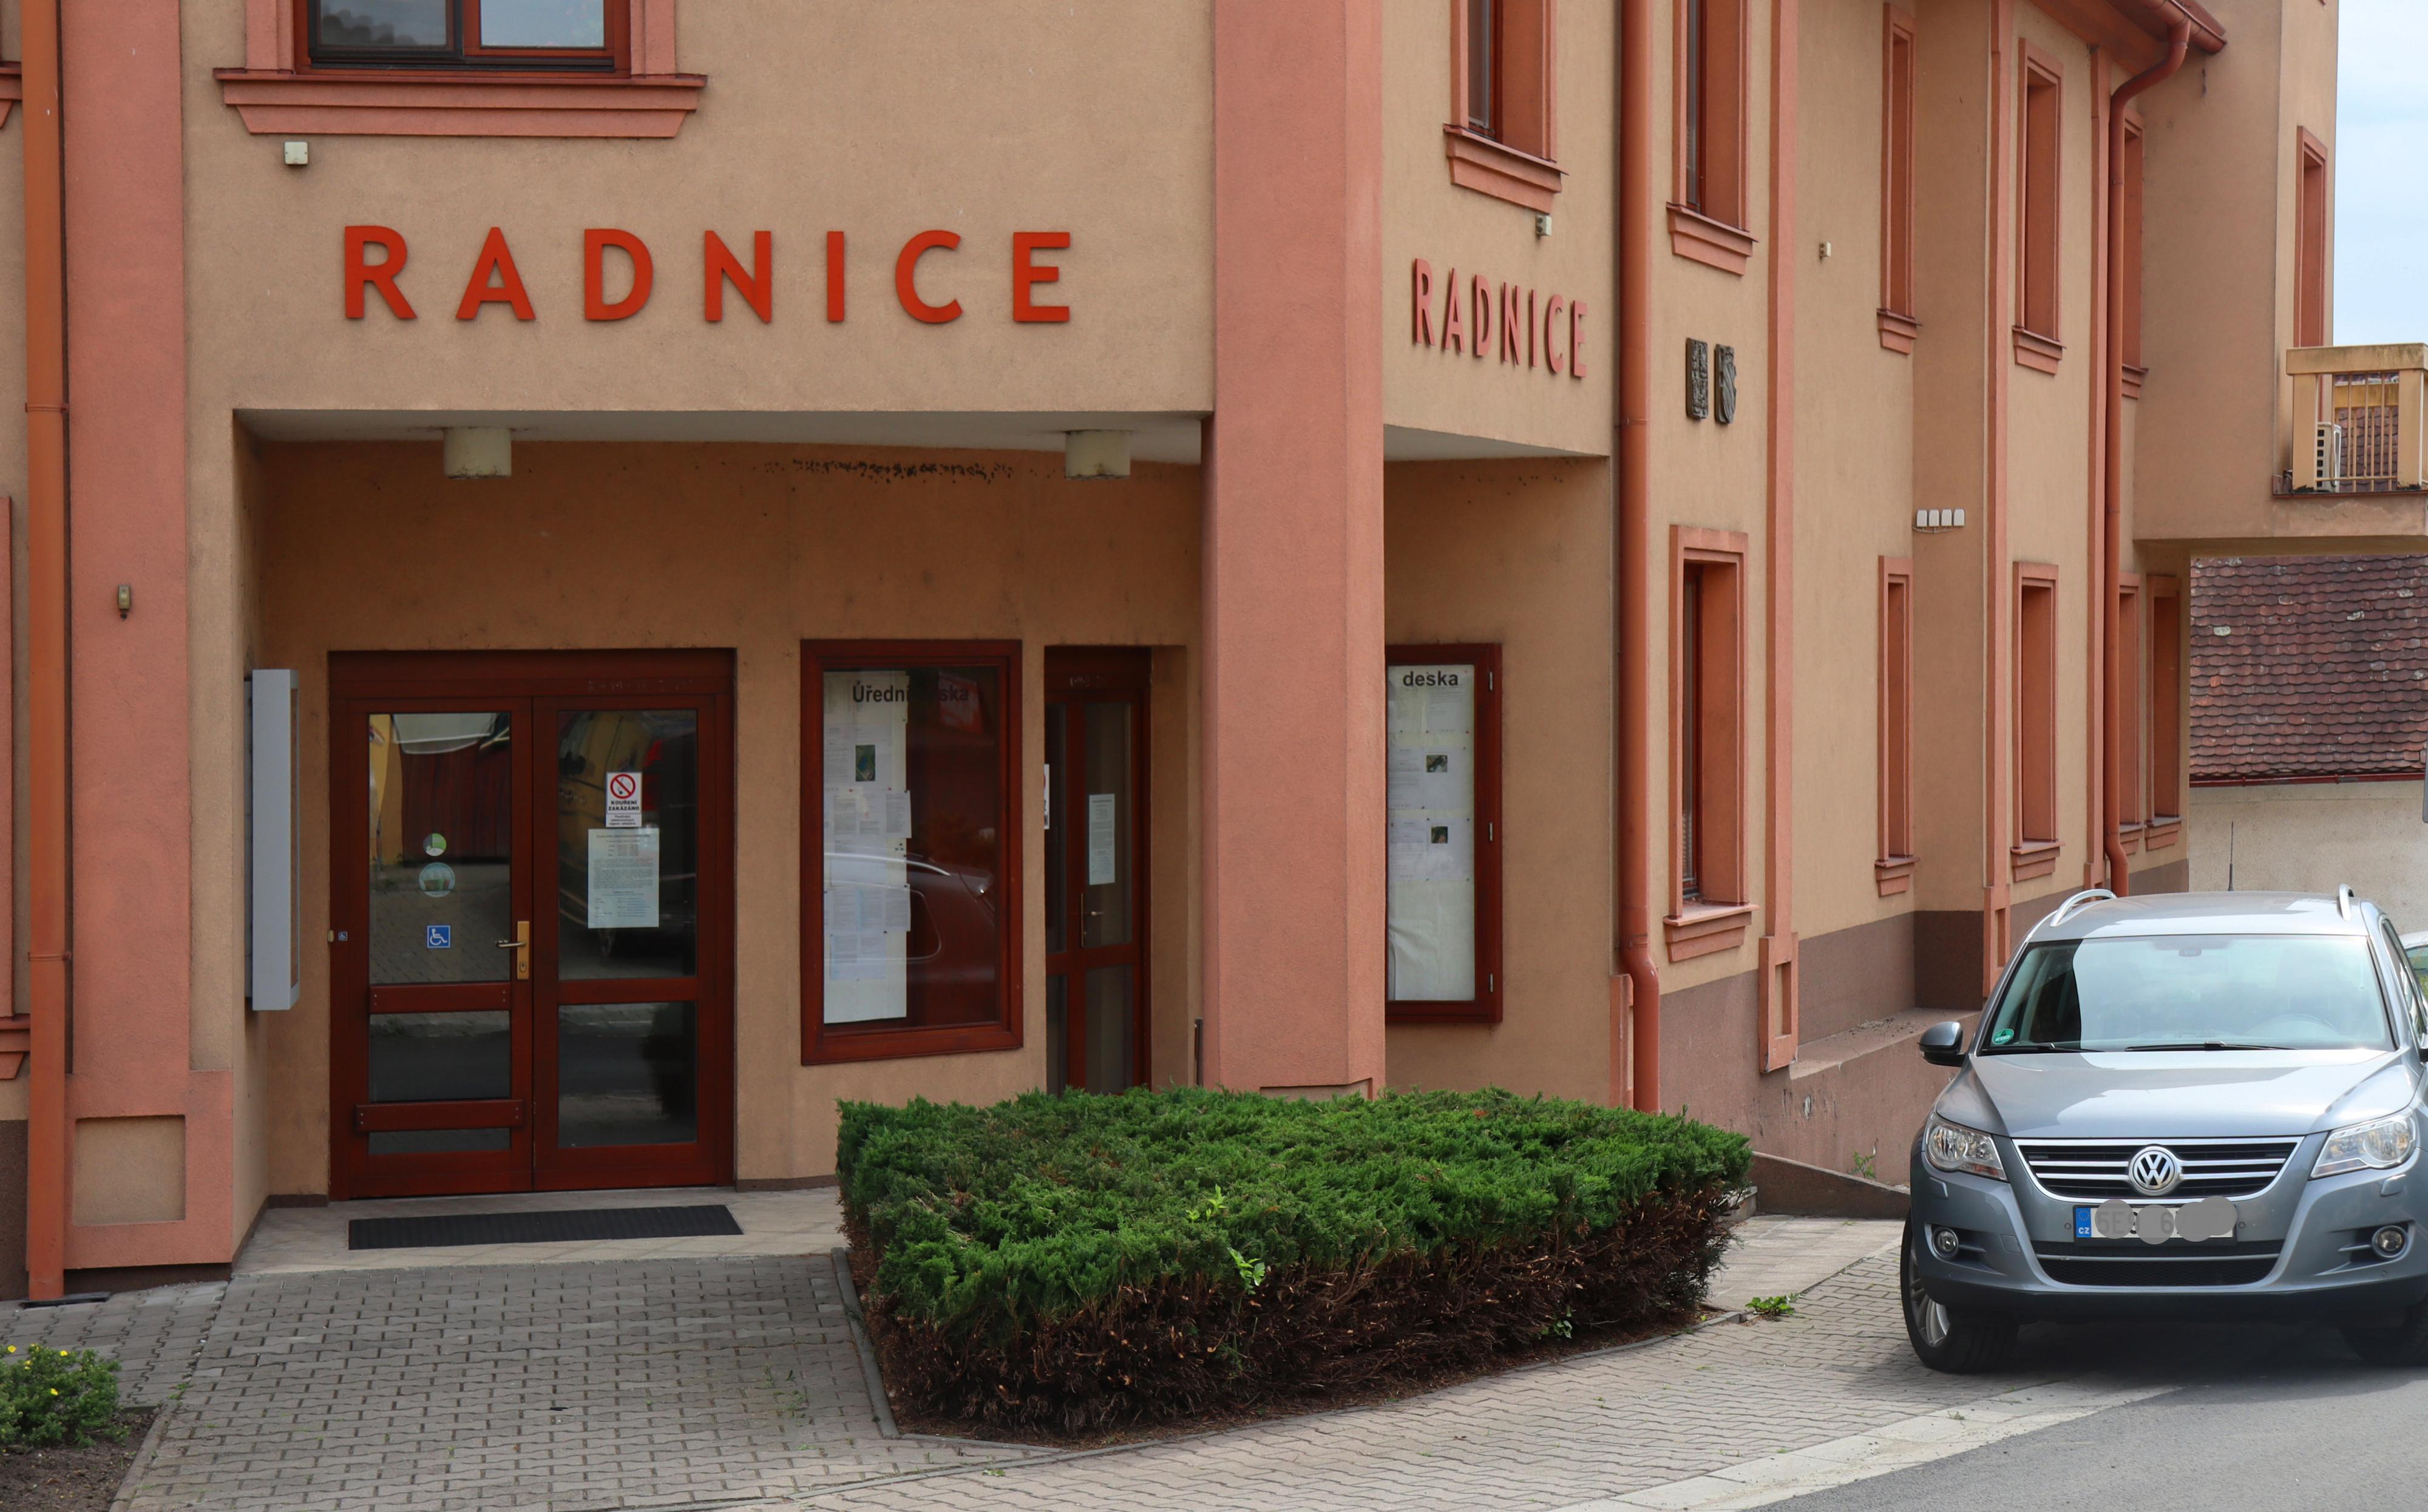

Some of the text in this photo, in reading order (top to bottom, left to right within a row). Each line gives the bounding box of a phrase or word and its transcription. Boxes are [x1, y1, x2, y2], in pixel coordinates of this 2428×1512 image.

[344, 225, 1070, 324] RADNICE
[1411, 258, 1587, 378] RADNICE
[1403, 670, 1458, 687] deska
